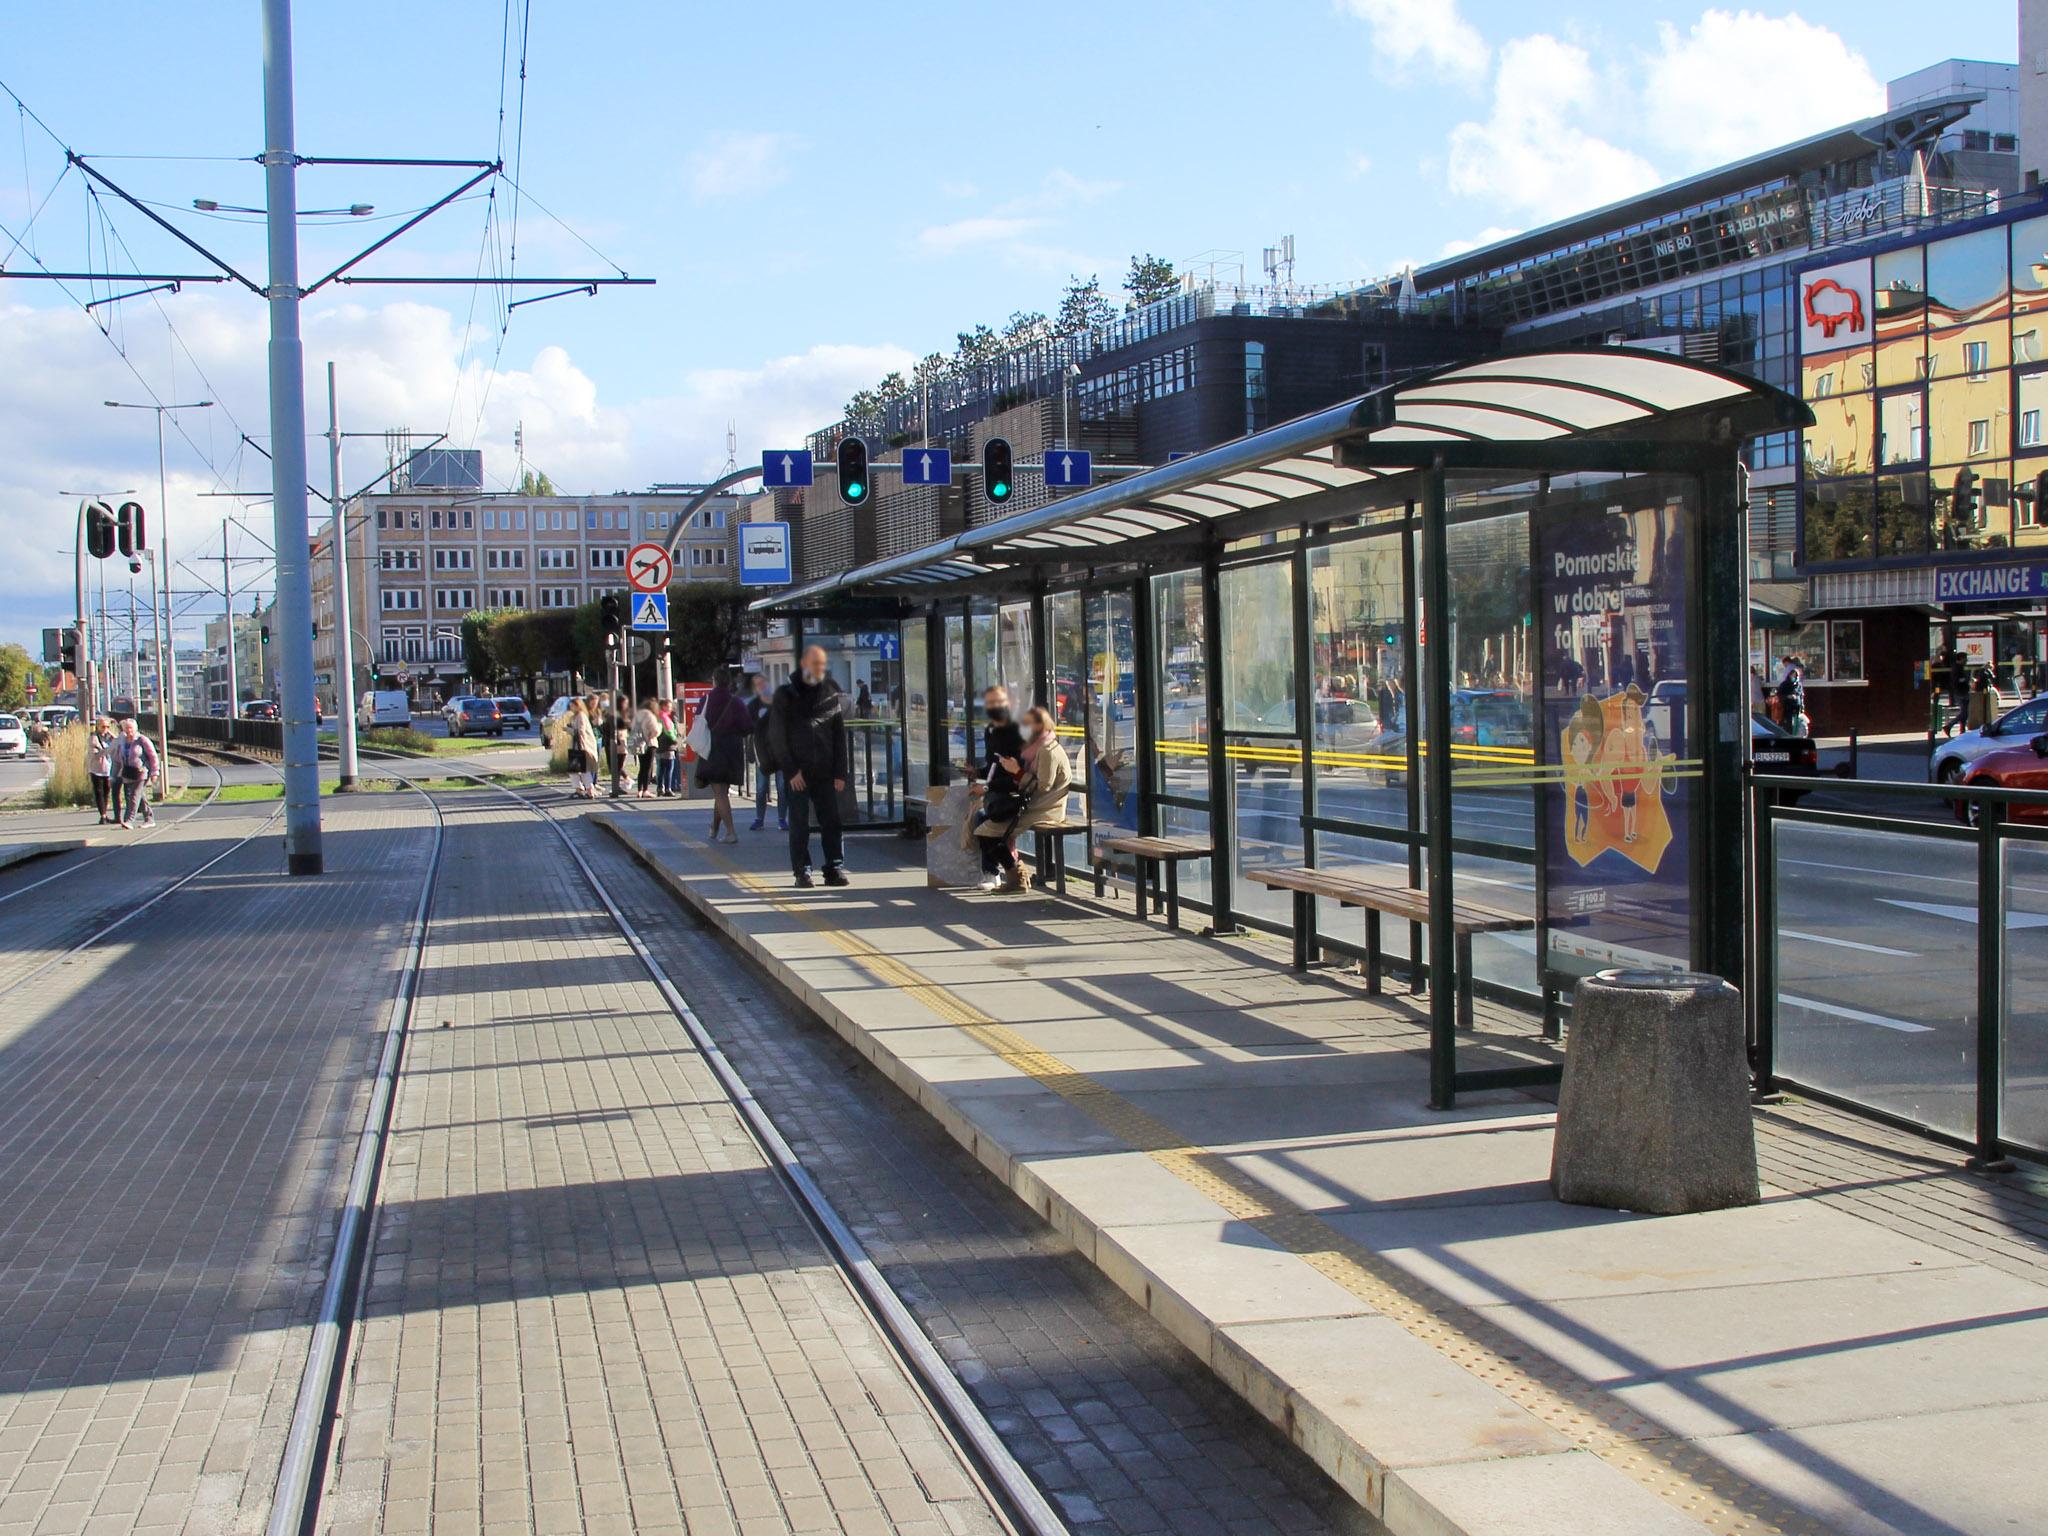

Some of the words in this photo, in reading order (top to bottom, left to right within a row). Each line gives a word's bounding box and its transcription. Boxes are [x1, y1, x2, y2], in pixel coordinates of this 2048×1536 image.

[1554, 543, 1640, 578] Pomorskie
[1939, 567, 2030, 597] EXCHANGE
[1554, 594, 1569, 613] w
[1572, 585, 1625, 616] dobrej
